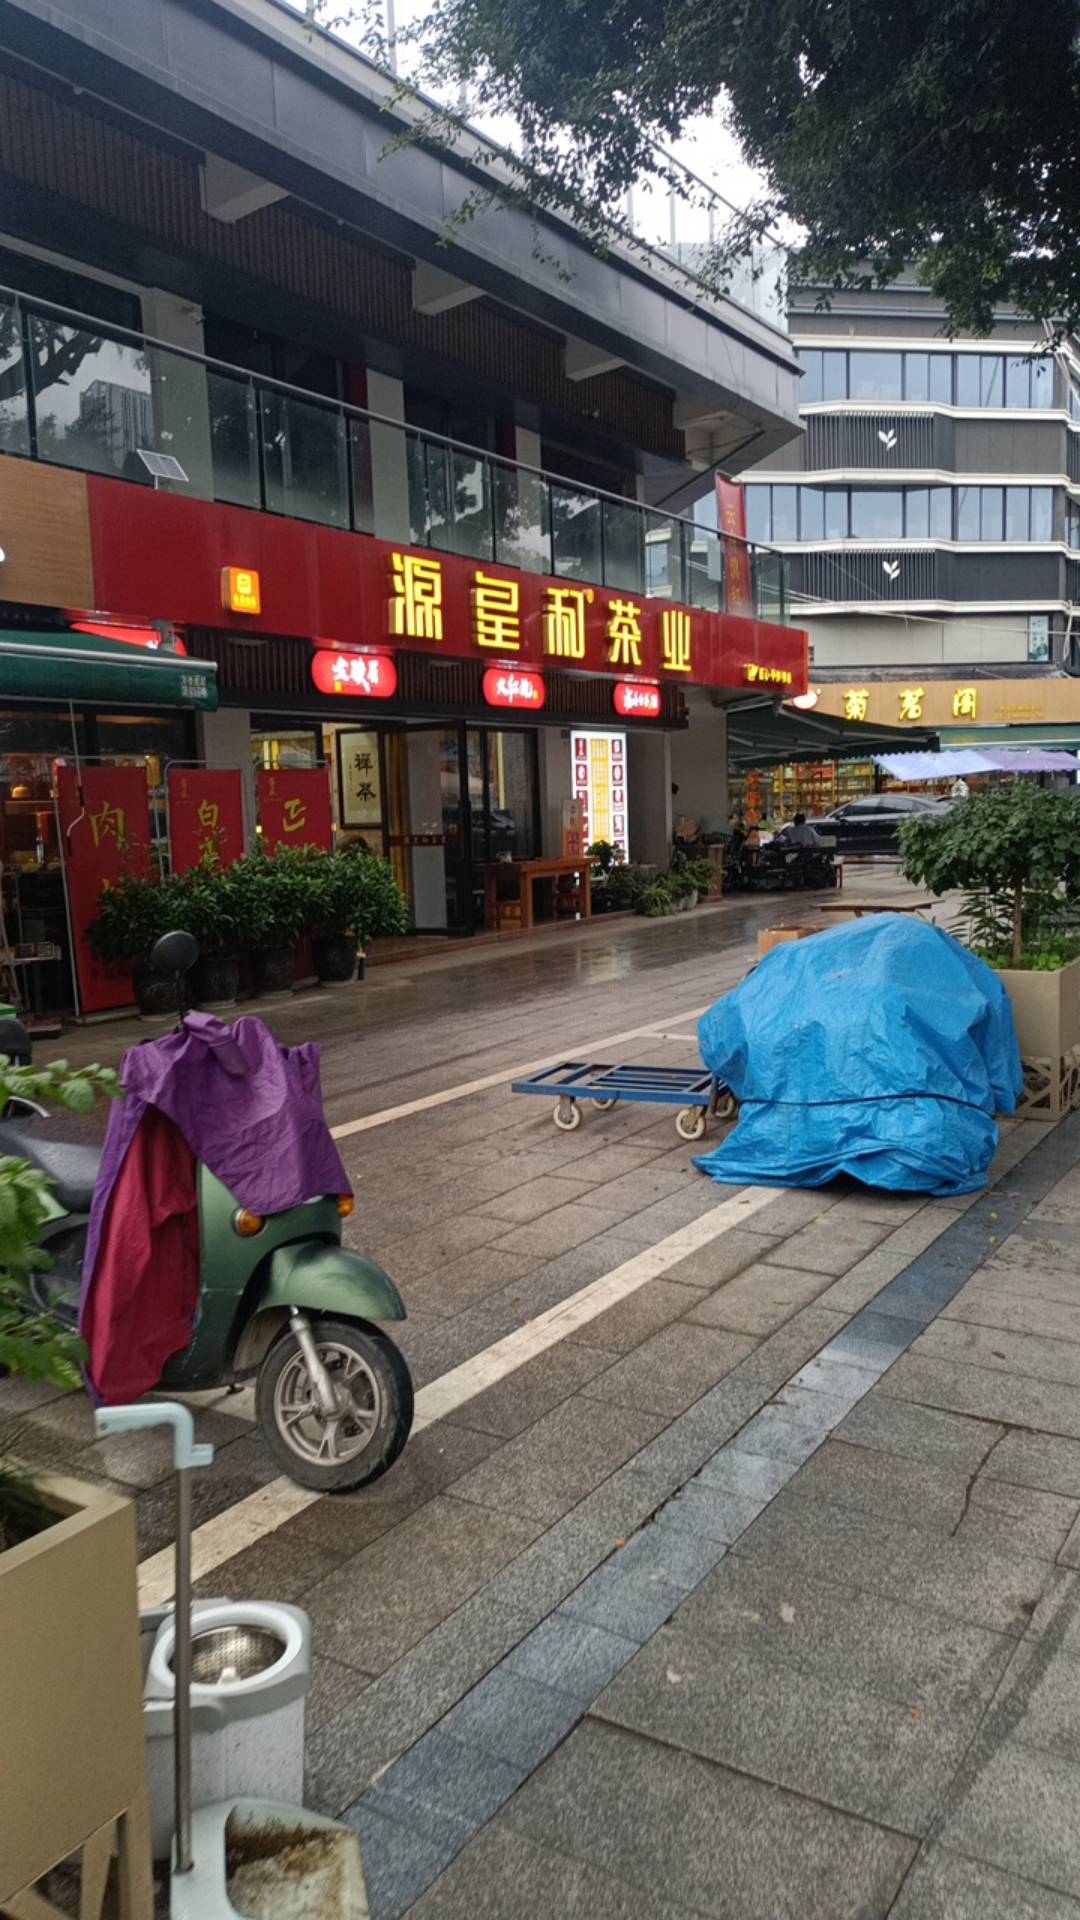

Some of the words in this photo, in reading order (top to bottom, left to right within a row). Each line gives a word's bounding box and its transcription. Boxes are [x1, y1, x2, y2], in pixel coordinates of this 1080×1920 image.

[389, 552, 693, 672] 源皇和茶业
